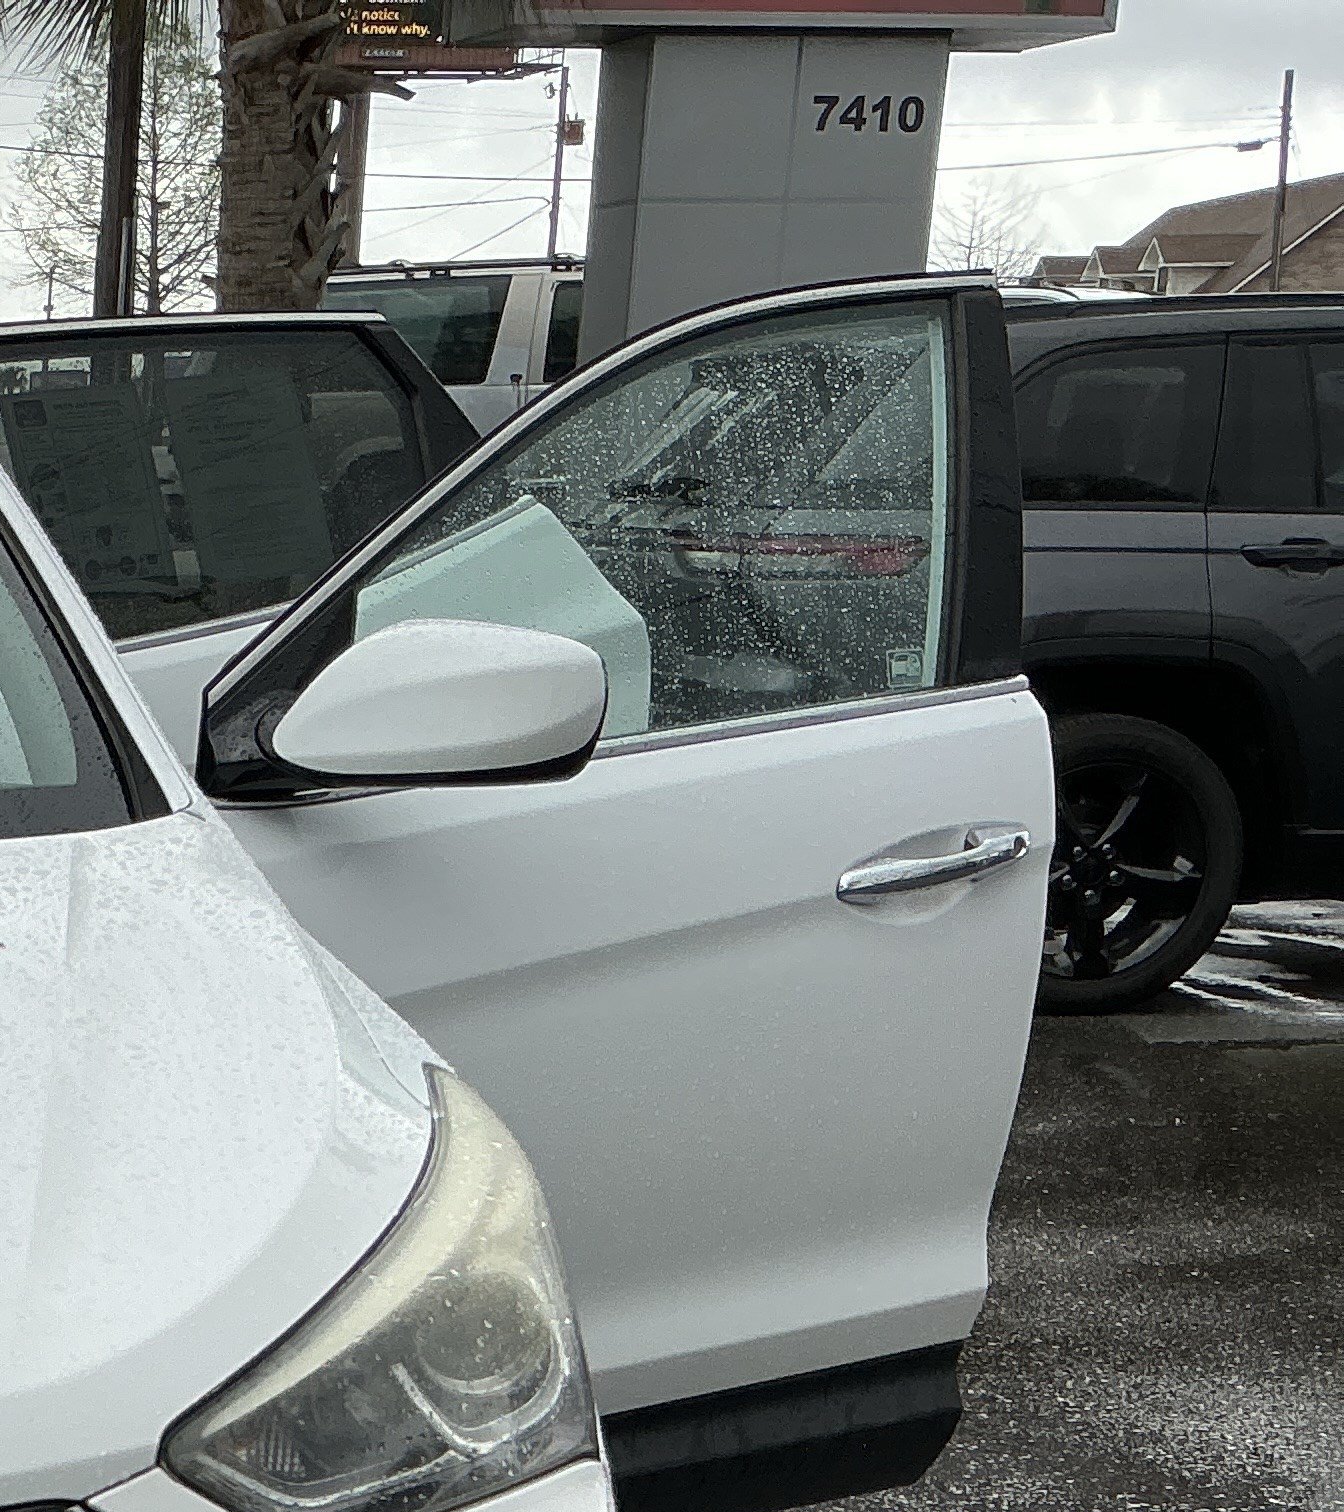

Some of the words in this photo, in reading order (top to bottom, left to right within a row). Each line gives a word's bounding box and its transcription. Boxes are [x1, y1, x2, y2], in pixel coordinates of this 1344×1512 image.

[361, 22, 398, 35] know
[400, 22, 431, 38] why.
[813, 95, 924, 133] 7410
